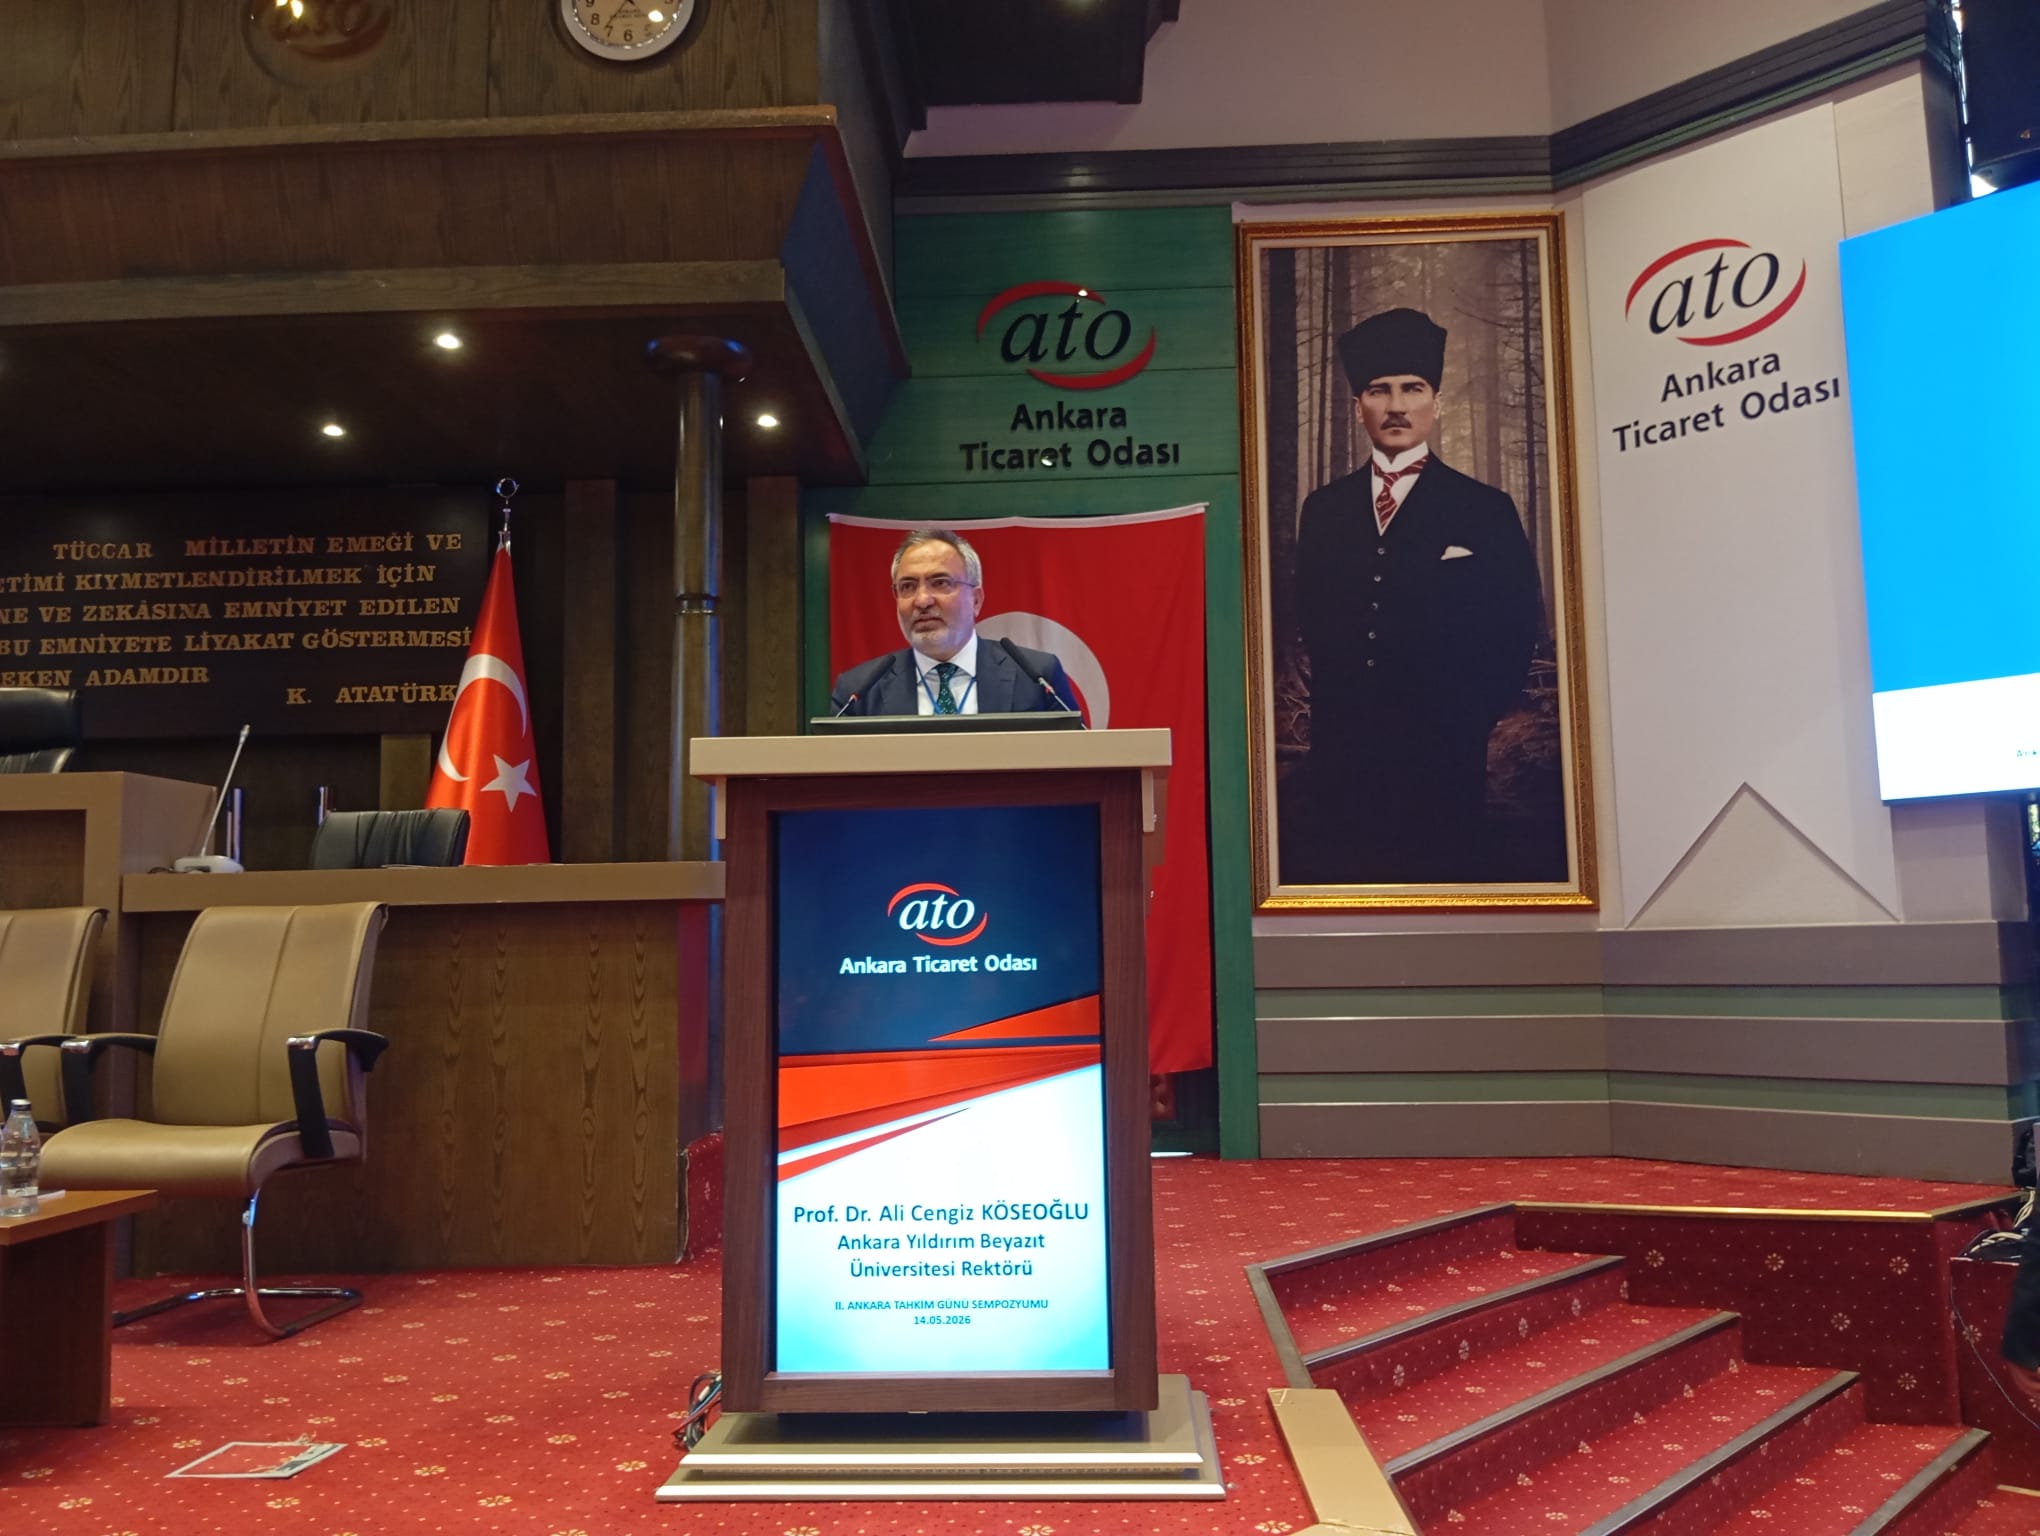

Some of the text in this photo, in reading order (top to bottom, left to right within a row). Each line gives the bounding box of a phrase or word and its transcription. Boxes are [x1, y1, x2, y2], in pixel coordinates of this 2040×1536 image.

[591, 12, 600, 25] 8
[623, 29, 633, 42] 6
[1648, 252, 1780, 335] ato
[1001, 299, 1131, 363] ato
[1661, 353, 1781, 403] Ankara
[1010, 400, 1127, 431] Ankara
[1612, 377, 1841, 452] Ticaret Odası
[959, 436, 1180, 471] Ticaret Odası
[53, 531, 462, 561] TÜCCAR MİLLETİN EMEĞİ VE
[75, 565, 362, 591] KIYMETLENDİRİLMEK
[376, 563, 436, 588] İÇİN
[38, 606, 72, 623] VE
[82, 600, 212, 622] ZEKÂSINA
[223, 597, 347, 619] EMNİYET
[39, 633, 172, 655] EMNİYETE
[184, 631, 295, 652] LİYAKAT
[302, 626, 472, 650] GÖSTERMESİ
[85, 667, 209, 687] ADAMDIR
[286, 682, 457, 705] K. ATATÜRK
[899, 894, 975, 930] ato
[839, 953, 1038, 974] Ankara Ticaret Odası
[793, 1199, 1089, 1225] Prof. Dr. Ali Cengiz KÖSEOĞLU
[837, 1233, 1046, 1252] Ankara Yıldırım Beyazıt
[850, 1258, 1033, 1278] Üniversitesi Rektörü
[834, 1301, 845, 1311] II.
[847, 1301, 892, 1311] ANKARA
[971, 1299, 1049, 1309] SEMPOZYUMU
[913, 1315, 972, 1325] 14.05.2026
